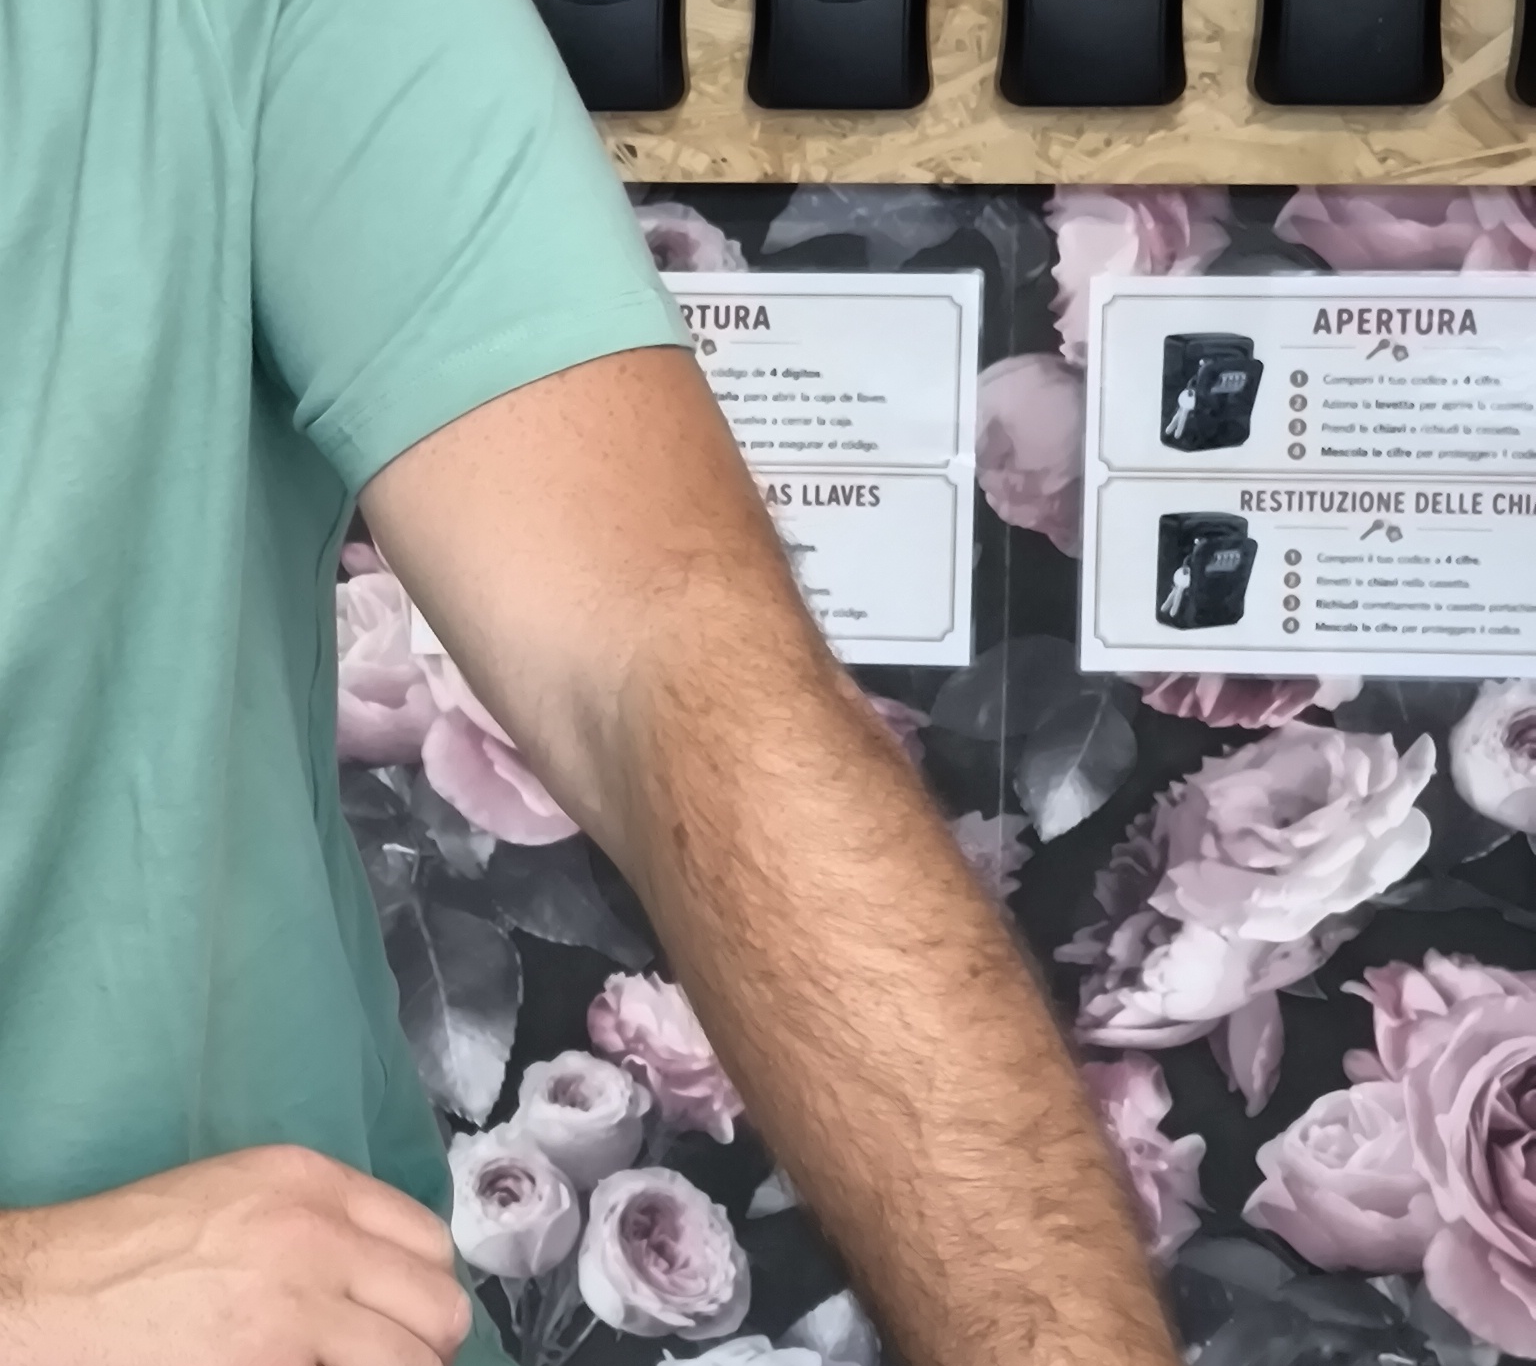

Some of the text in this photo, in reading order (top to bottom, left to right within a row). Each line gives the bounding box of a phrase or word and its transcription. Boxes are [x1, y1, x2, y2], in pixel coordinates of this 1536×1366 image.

[1313, 307, 1478, 336] APERTURA
[802, 484, 882, 509] LLAVES
[1240, 490, 1406, 514] RESTITUZIONE
[1415, 491, 1483, 515] DELLE
